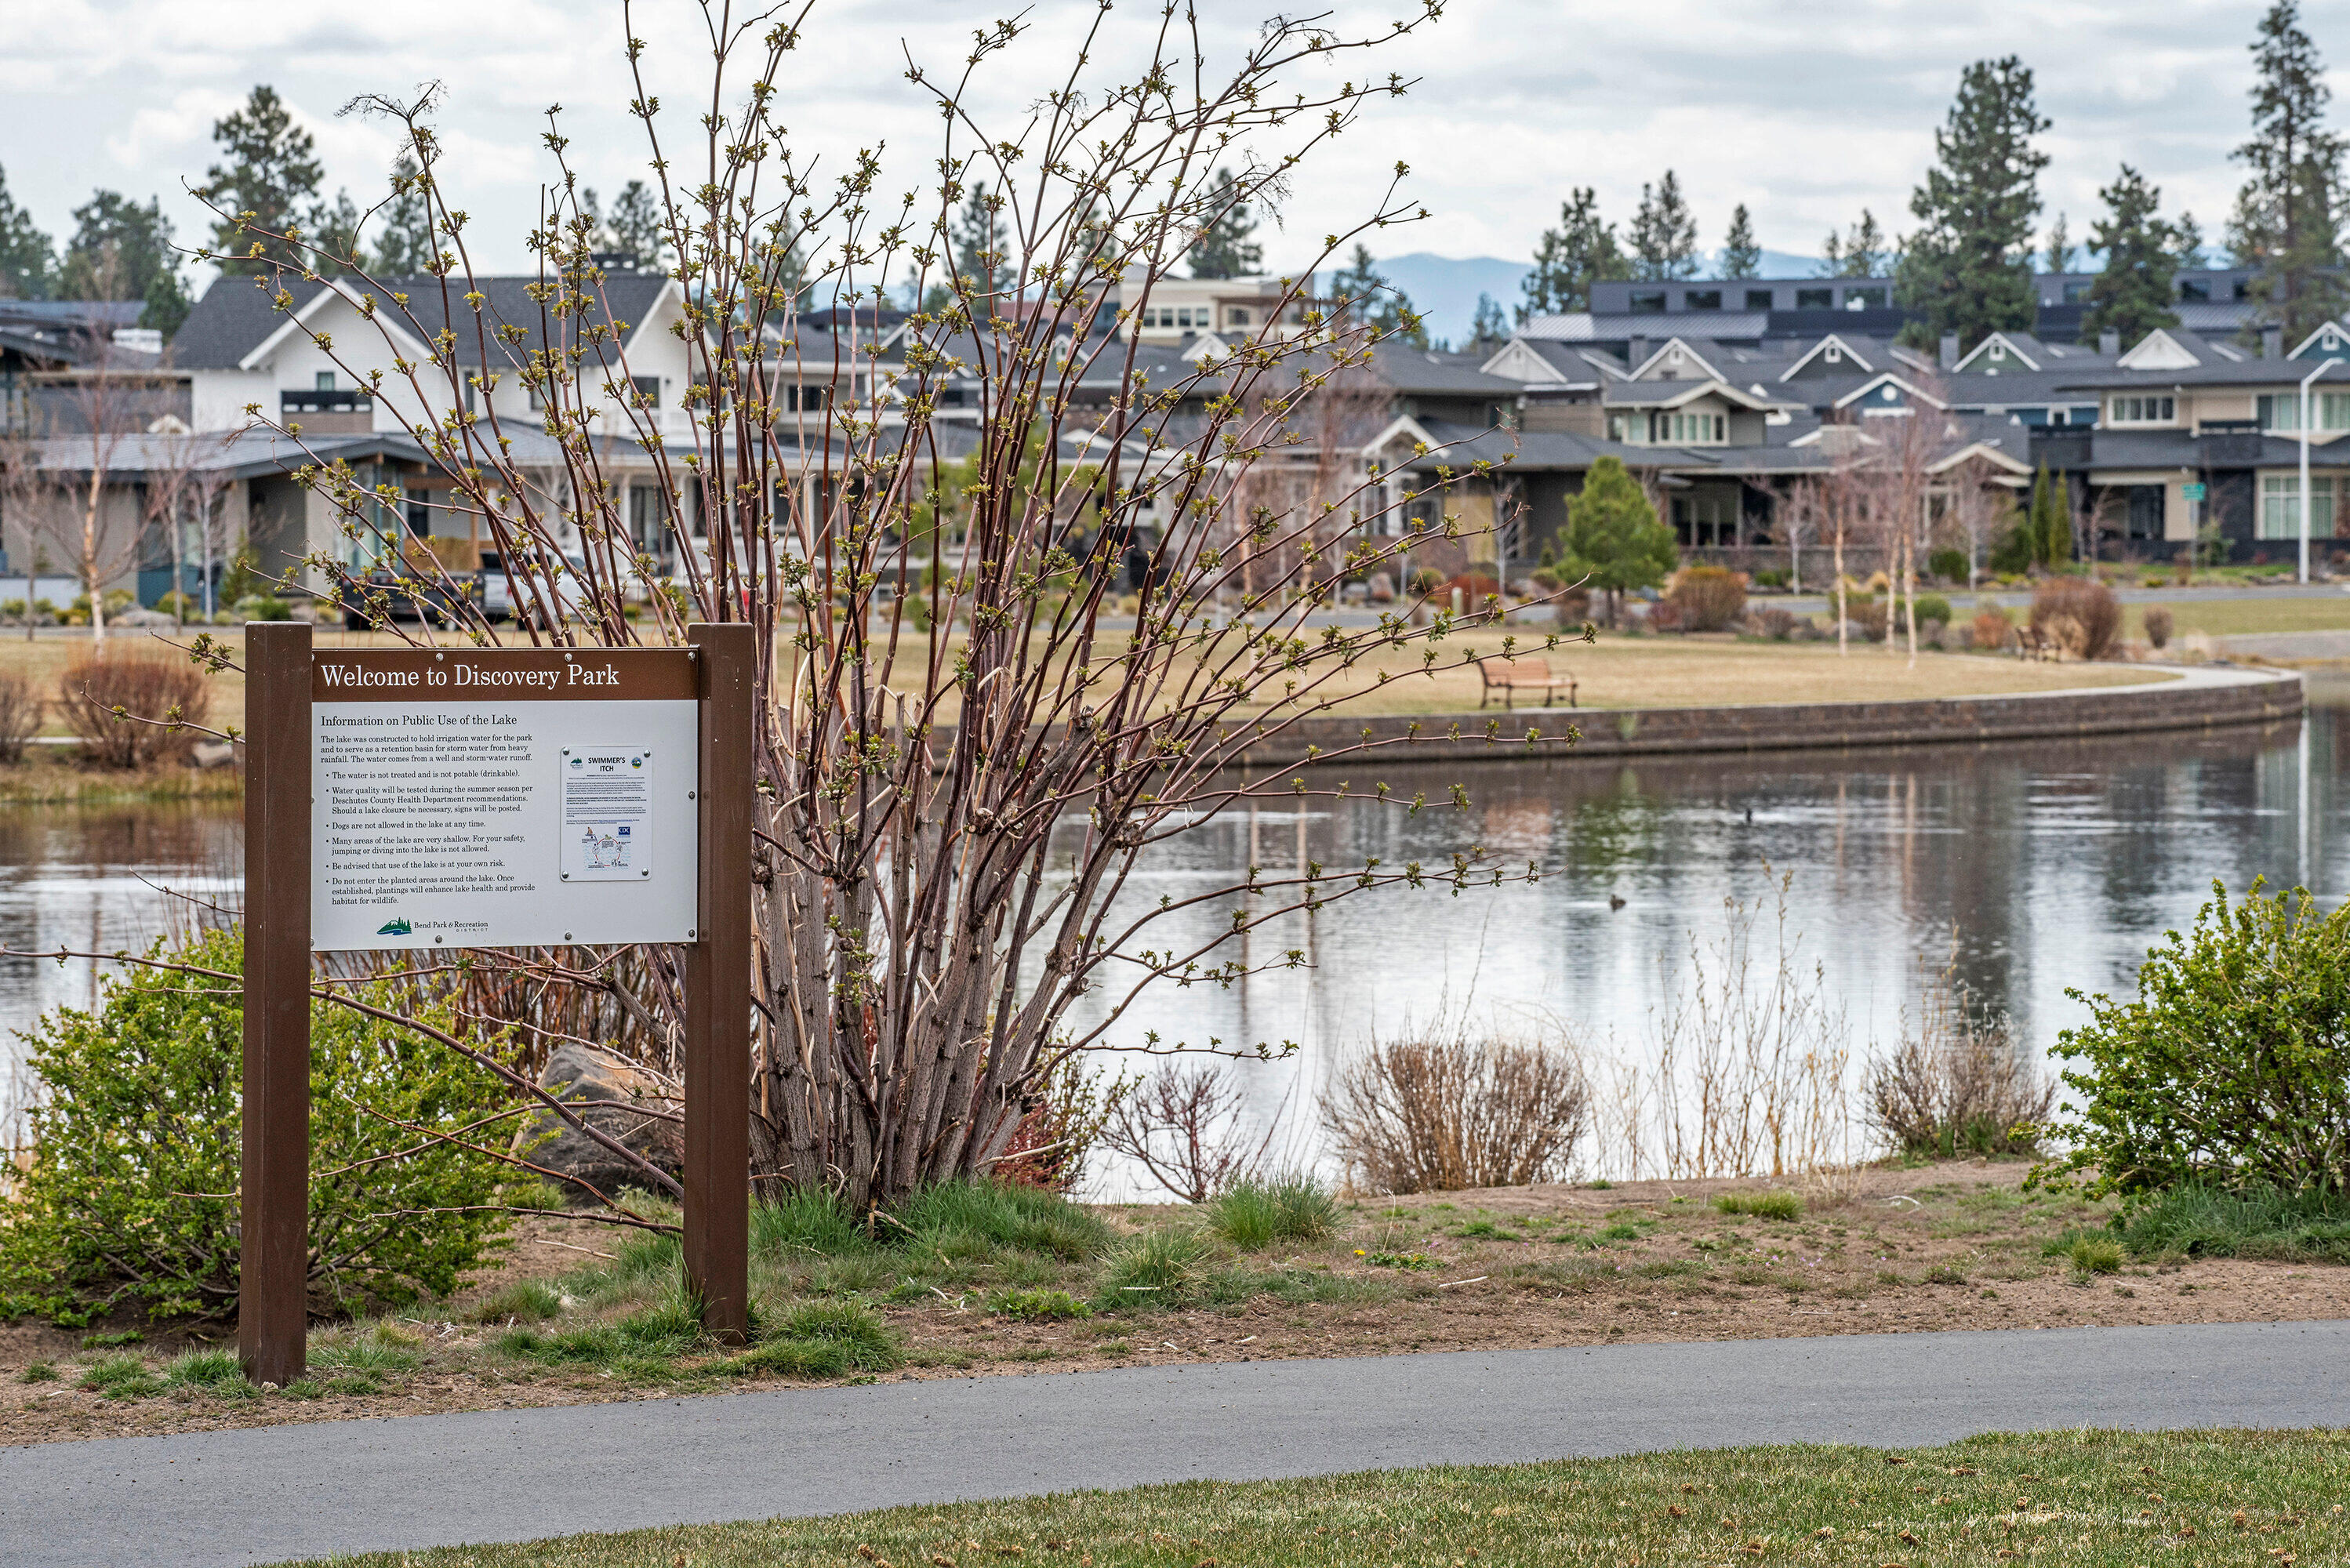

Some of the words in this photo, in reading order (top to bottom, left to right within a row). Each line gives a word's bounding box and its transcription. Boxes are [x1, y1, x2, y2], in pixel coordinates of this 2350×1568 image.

[321, 665, 419, 687] Welcome
[426, 666, 447, 686] to
[454, 664, 561, 690] Discovery
[567, 664, 619, 685] Park
[321, 715, 383, 726] Information
[402, 715, 434, 725] Public
[438, 715, 457, 725] Use
[459, 714, 470, 724] of
[472, 714, 489, 724] the
[492, 714, 517, 724] Lake
[436, 734, 469, 743] irrigation
[516, 734, 532, 742] park
[320, 745, 335, 753] and
[508, 744, 528, 753] heavy
[320, 754, 349, 764] rainfall.
[453, 770, 478, 779] potable
[480, 768, 520, 777] (drinkable).
[355, 786, 380, 795] quality
[429, 786, 452, 794] during
[369, 796, 395, 804] County
[423, 796, 465, 804] Department
[467, 794, 528, 803] recommendations.
[332, 806, 357, 815] Should
[454, 805, 472, 814] signs
[498, 804, 522, 813] posted.
[332, 822, 350, 831] Dogs
[332, 837, 352, 846] Many
[503, 834, 525, 843] safety,
[331, 847, 361, 856] jumping
[372, 846, 394, 855] diving
[390, 876, 417, 885] planted
[332, 887, 373, 895] established,
[376, 886, 409, 895] plantings
[495, 884, 508, 892] and
[510, 883, 536, 892] provide
